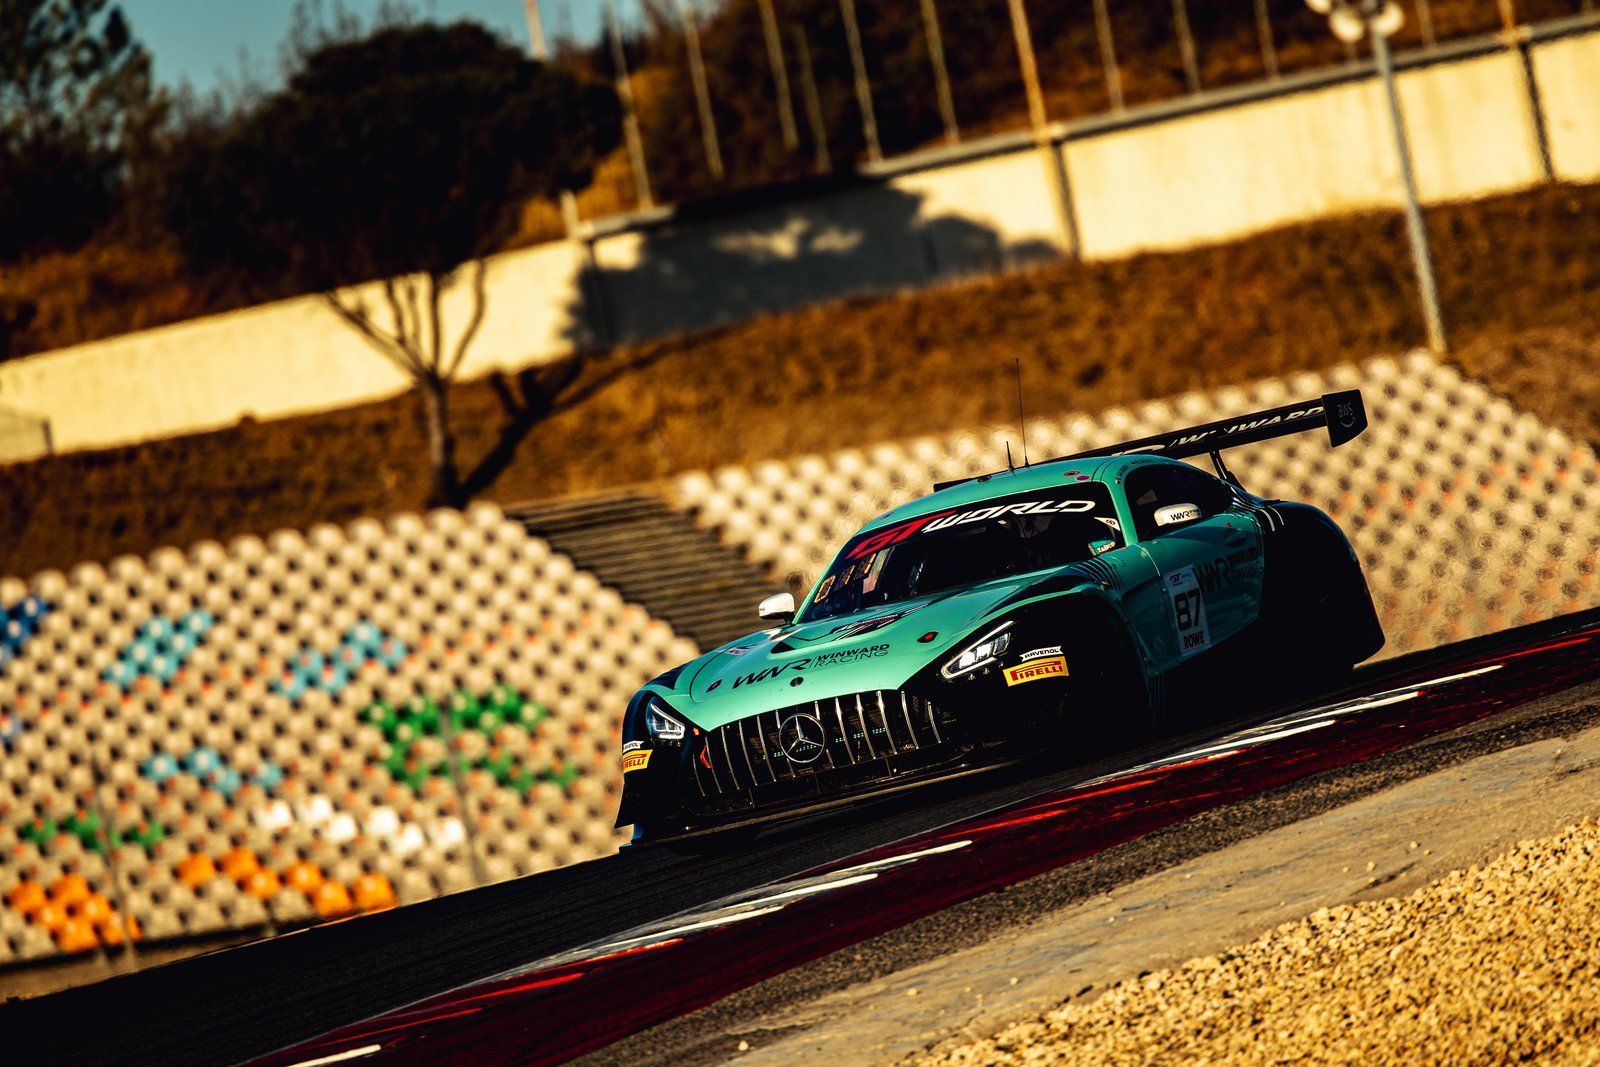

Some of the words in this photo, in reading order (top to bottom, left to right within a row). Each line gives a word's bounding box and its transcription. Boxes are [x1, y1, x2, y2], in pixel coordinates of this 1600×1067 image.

[921, 500, 1096, 533] WORLD
[1175, 588, 1200, 631] 87
[1184, 631, 1205, 649] ROWE
[814, 649, 889, 668] RACING
[817, 644, 889, 661] WINWARD
[1024, 648, 1059, 658] RAVENOL
[1010, 661, 1063, 681] PIRELLI
[624, 754, 647, 769] RELLI
